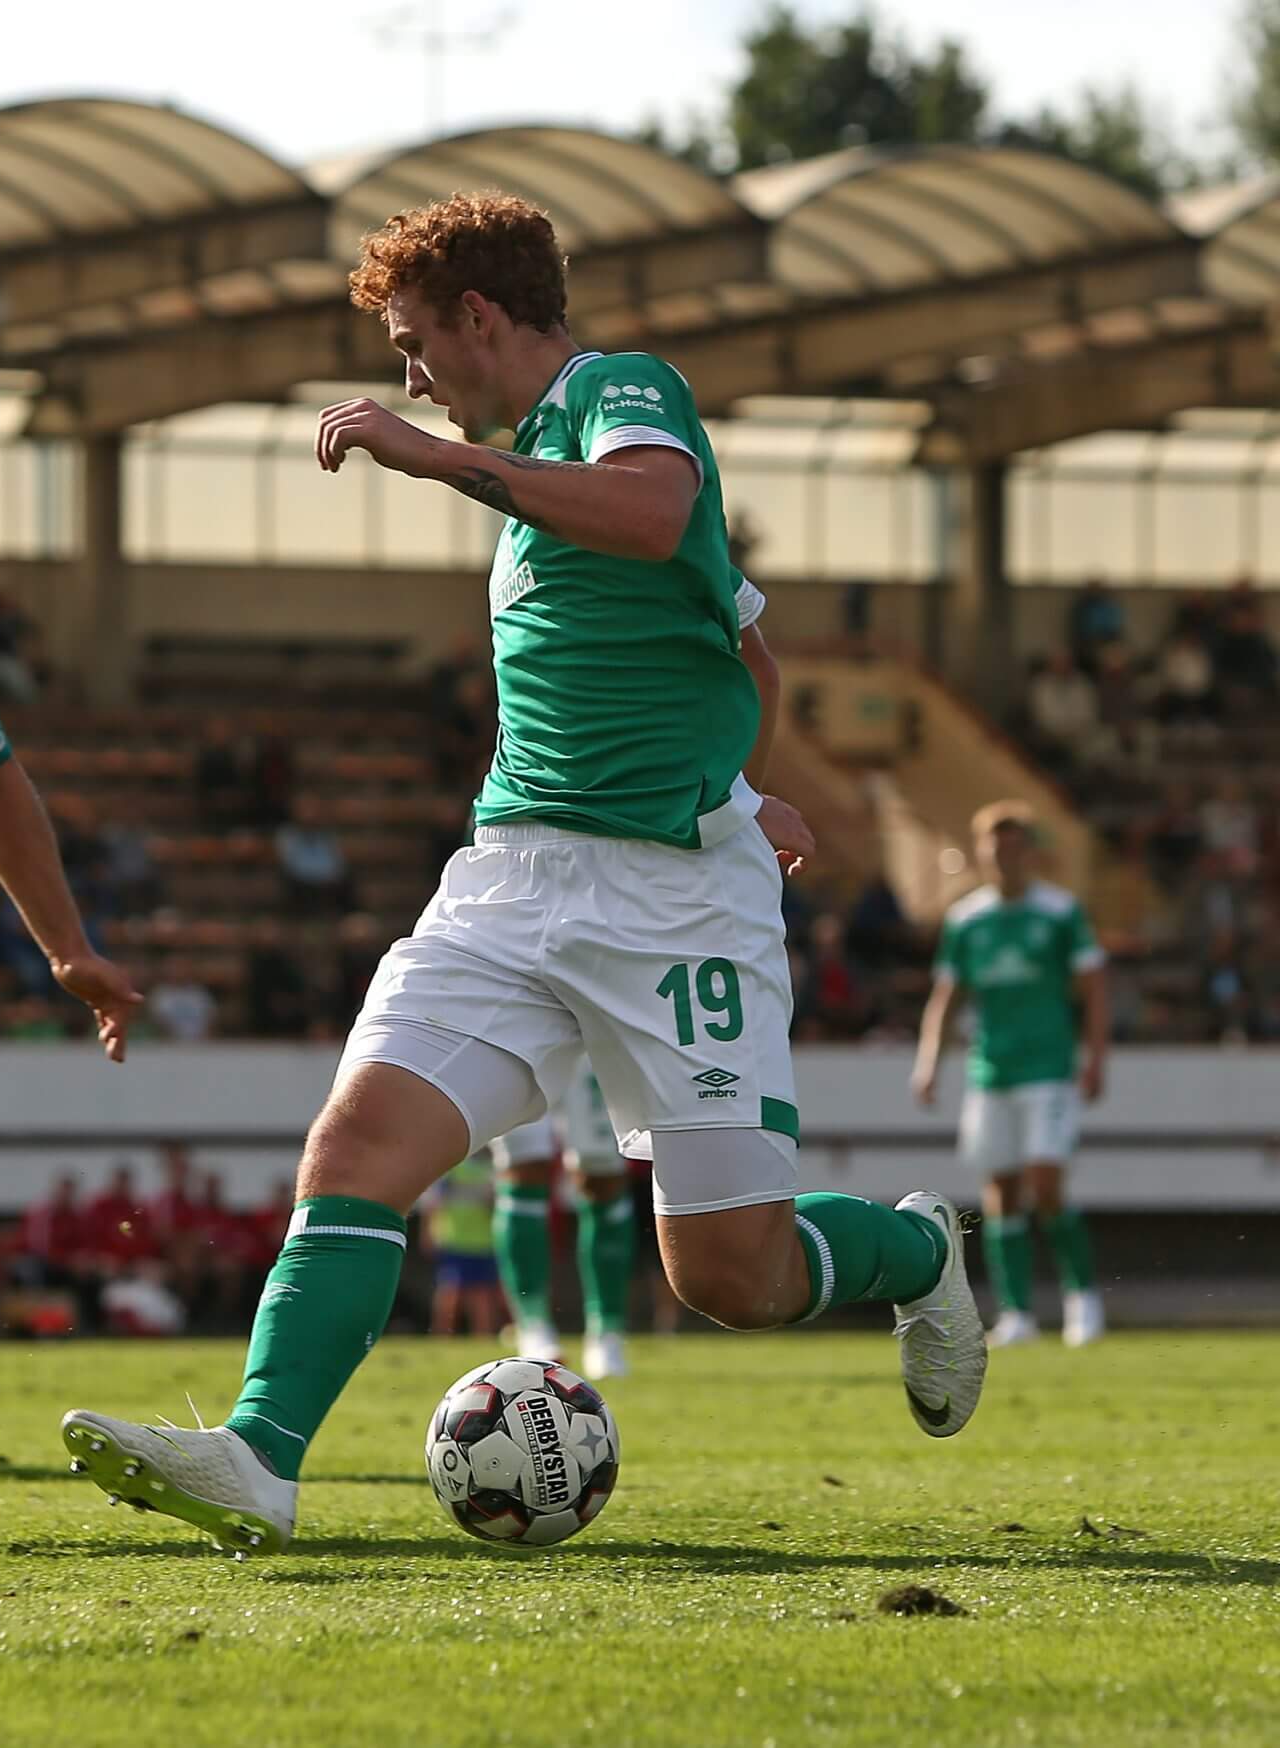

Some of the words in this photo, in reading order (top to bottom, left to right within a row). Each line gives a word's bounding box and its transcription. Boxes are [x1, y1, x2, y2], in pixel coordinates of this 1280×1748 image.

[655, 956, 744, 1047] 19
[698, 1088, 737, 1099] umbro
[526, 1397, 569, 1505] DERBYSTAR
